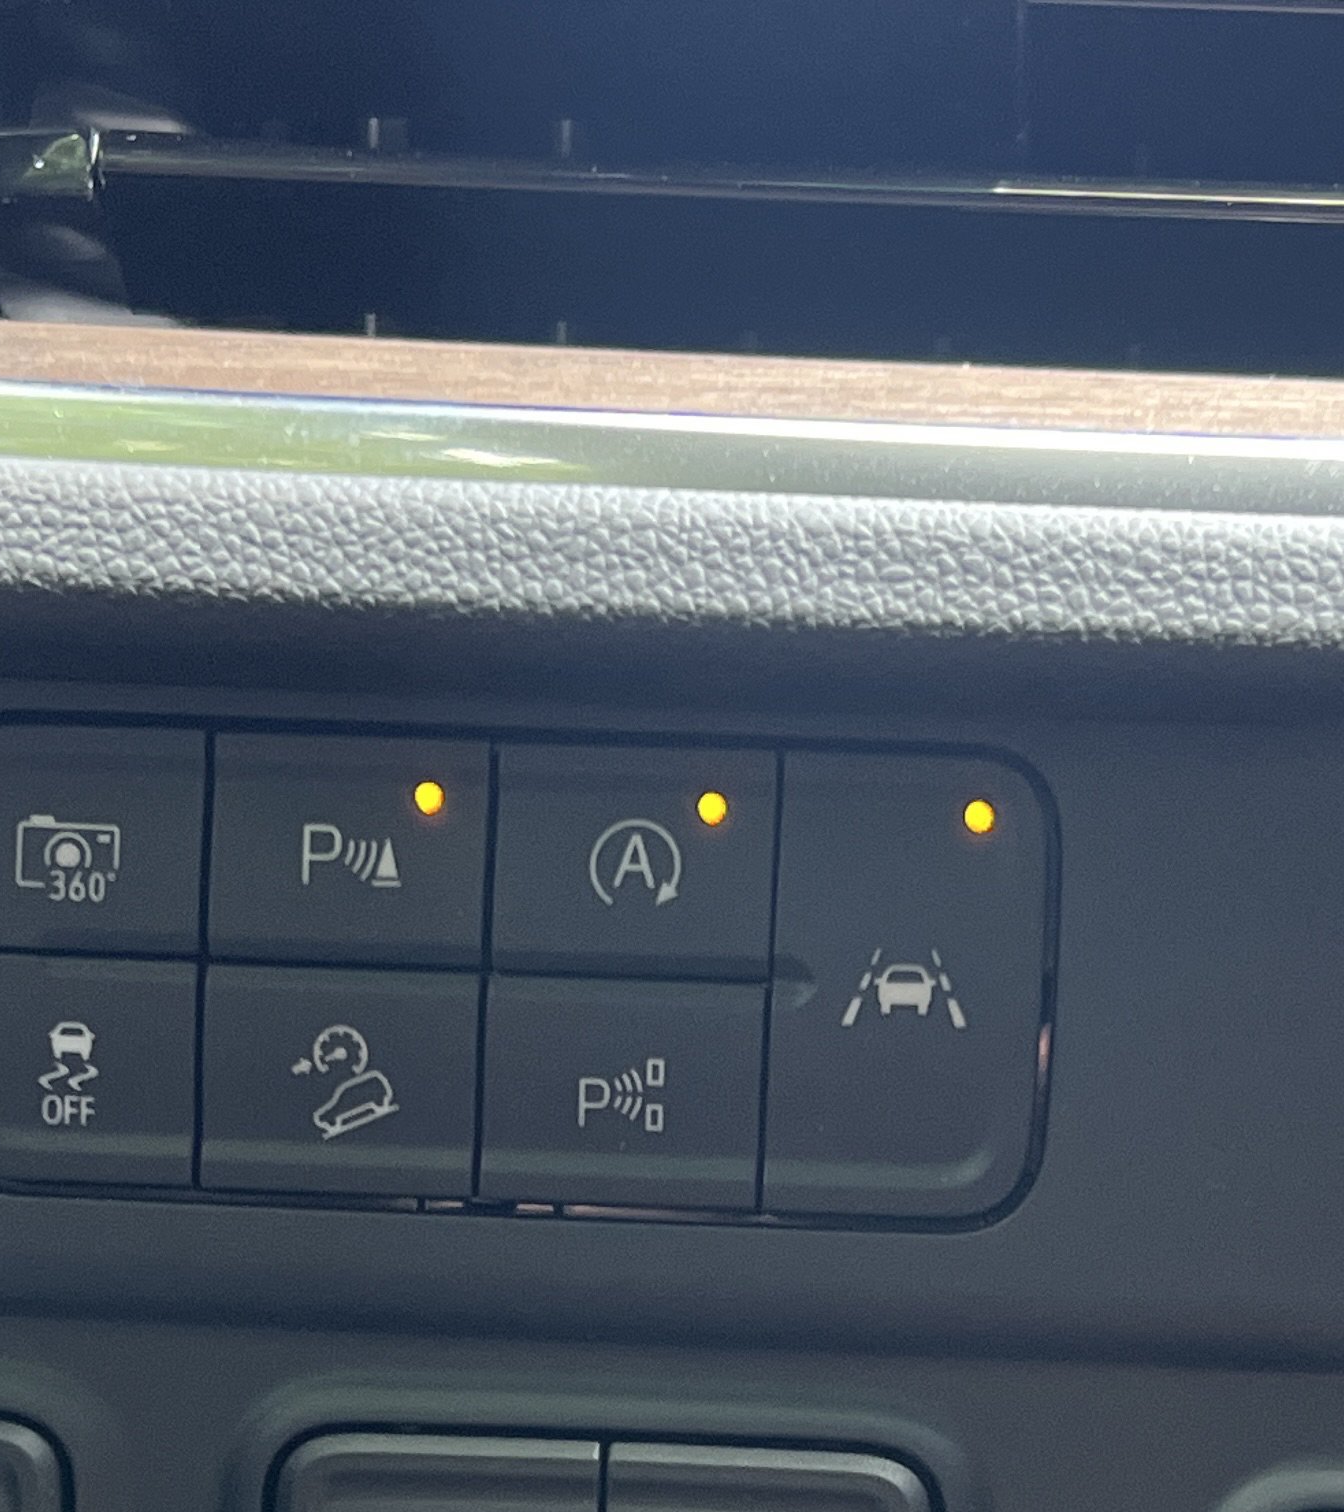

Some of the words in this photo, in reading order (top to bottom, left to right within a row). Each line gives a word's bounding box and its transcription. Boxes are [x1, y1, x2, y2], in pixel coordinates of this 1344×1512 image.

[301, 823, 341, 885] P
[613, 835, 655, 889] A
[41, 1089, 95, 1126] OFF
[578, 1077, 610, 1127] P
